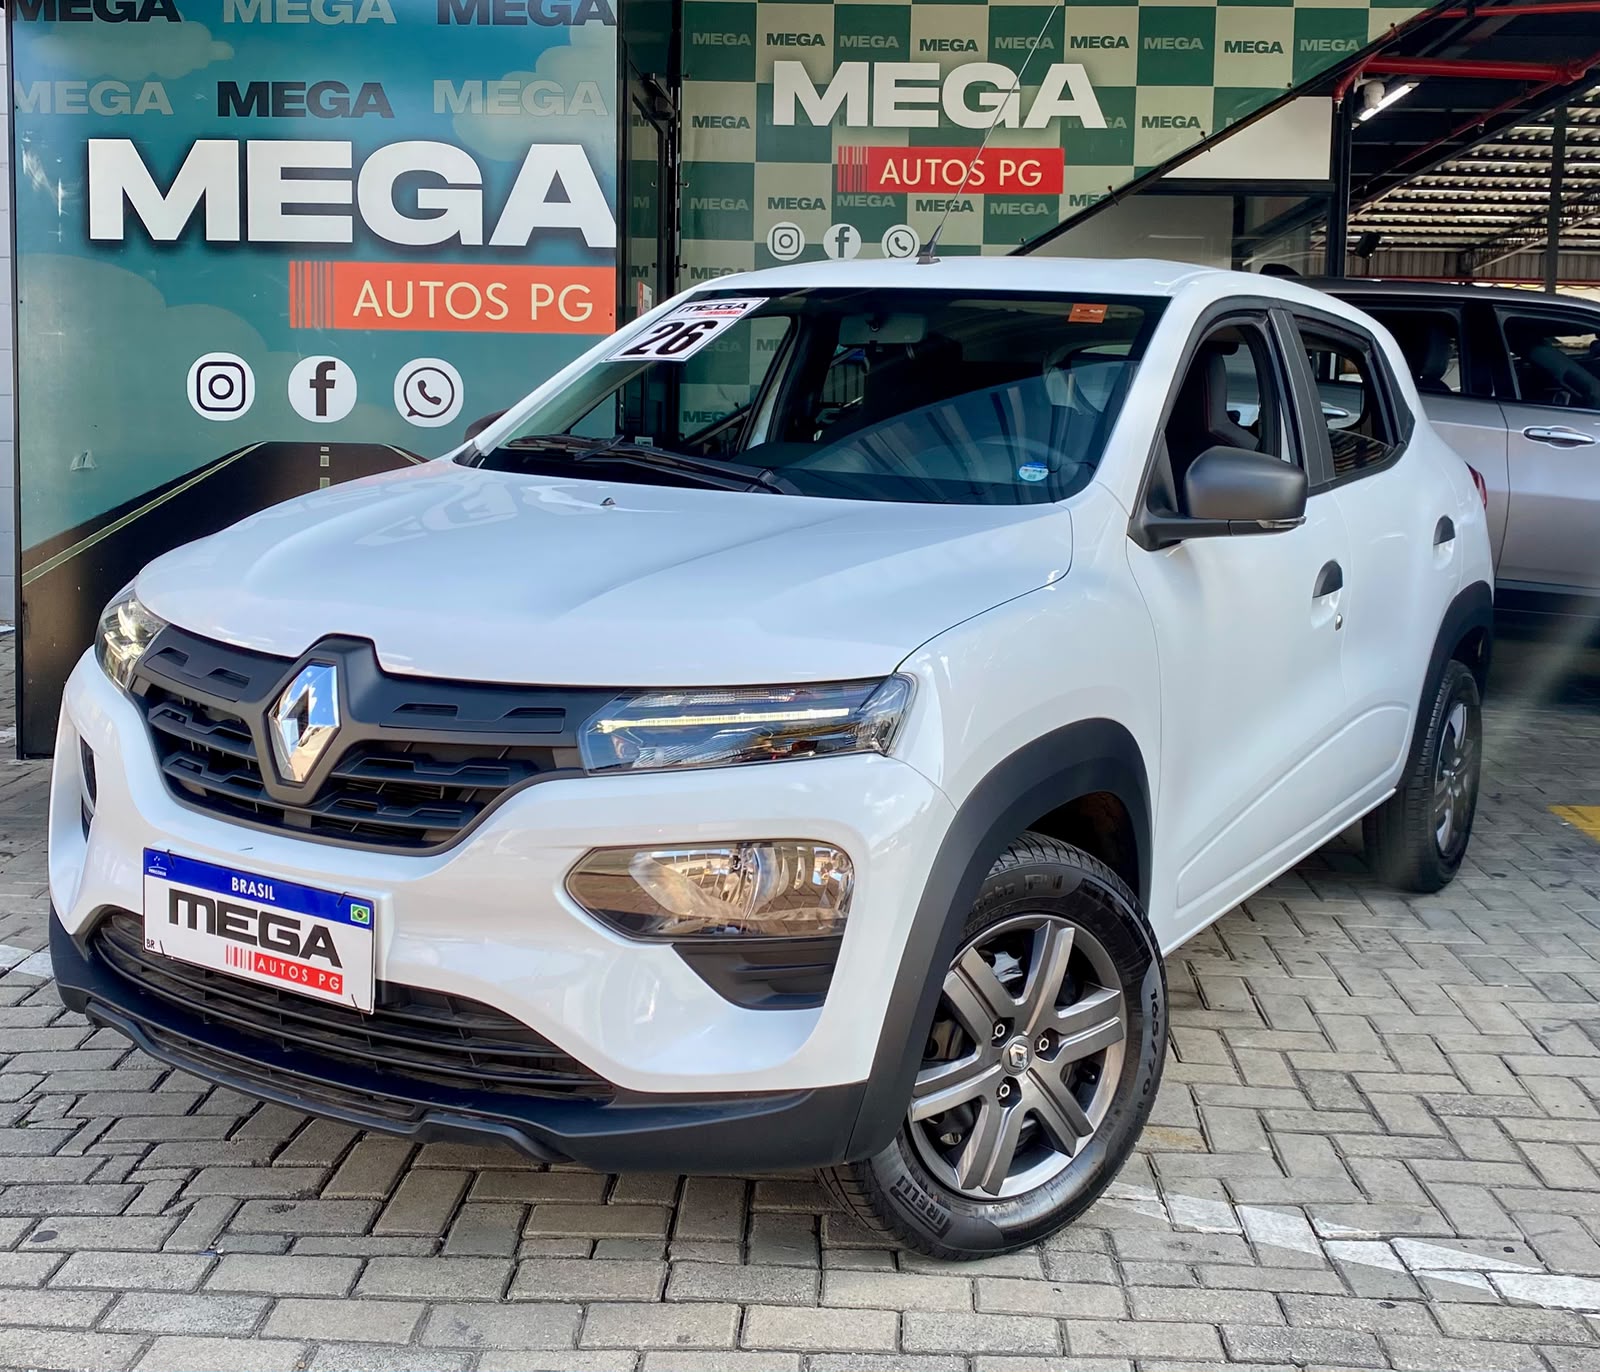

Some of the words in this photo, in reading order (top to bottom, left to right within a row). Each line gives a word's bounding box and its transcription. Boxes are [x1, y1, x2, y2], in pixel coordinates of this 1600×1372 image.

[222, 0, 397, 24] MEGA
[437, 0, 617, 26] MEGA
[691, 33, 751, 46] MEGA
[766, 33, 826, 47] MEGA
[839, 35, 899, 49] MEGA
[919, 39, 978, 52] MEGA
[994, 37, 1054, 49] MEGA
[1070, 36, 1129, 49] MEGA
[1143, 37, 1204, 50] MEGA
[1300, 40, 1360, 52] MEGA
[1224, 41, 1284, 54] MEGA
[14, 80, 174, 116] MEGA
[217, 80, 395, 118] MEGA
[432, 79, 609, 117] MEGA
[773, 60, 1108, 129] MEGA
[691, 116, 751, 129] MEGA
[1141, 116, 1201, 129] MEGA
[879, 158, 985, 186] AUTOS
[1000, 160, 1043, 187] PG
[88, 138, 616, 247] MEGA
[690, 198, 749, 211] MEGA
[767, 197, 826, 210] MEGA
[836, 194, 896, 208] MEGA
[915, 199, 974, 212] MEGA
[989, 202, 1049, 215] MEGA
[353, 280, 508, 321] AUTOS
[531, 284, 593, 322] PG
[620, 320, 718, 356] 26
[231, 877, 276, 901] BRASIL
[169, 888, 343, 969] MEGA
[146, 939, 155, 949] BR
[257, 957, 308, 983] AUTOS
[317, 975, 341, 990] PG
